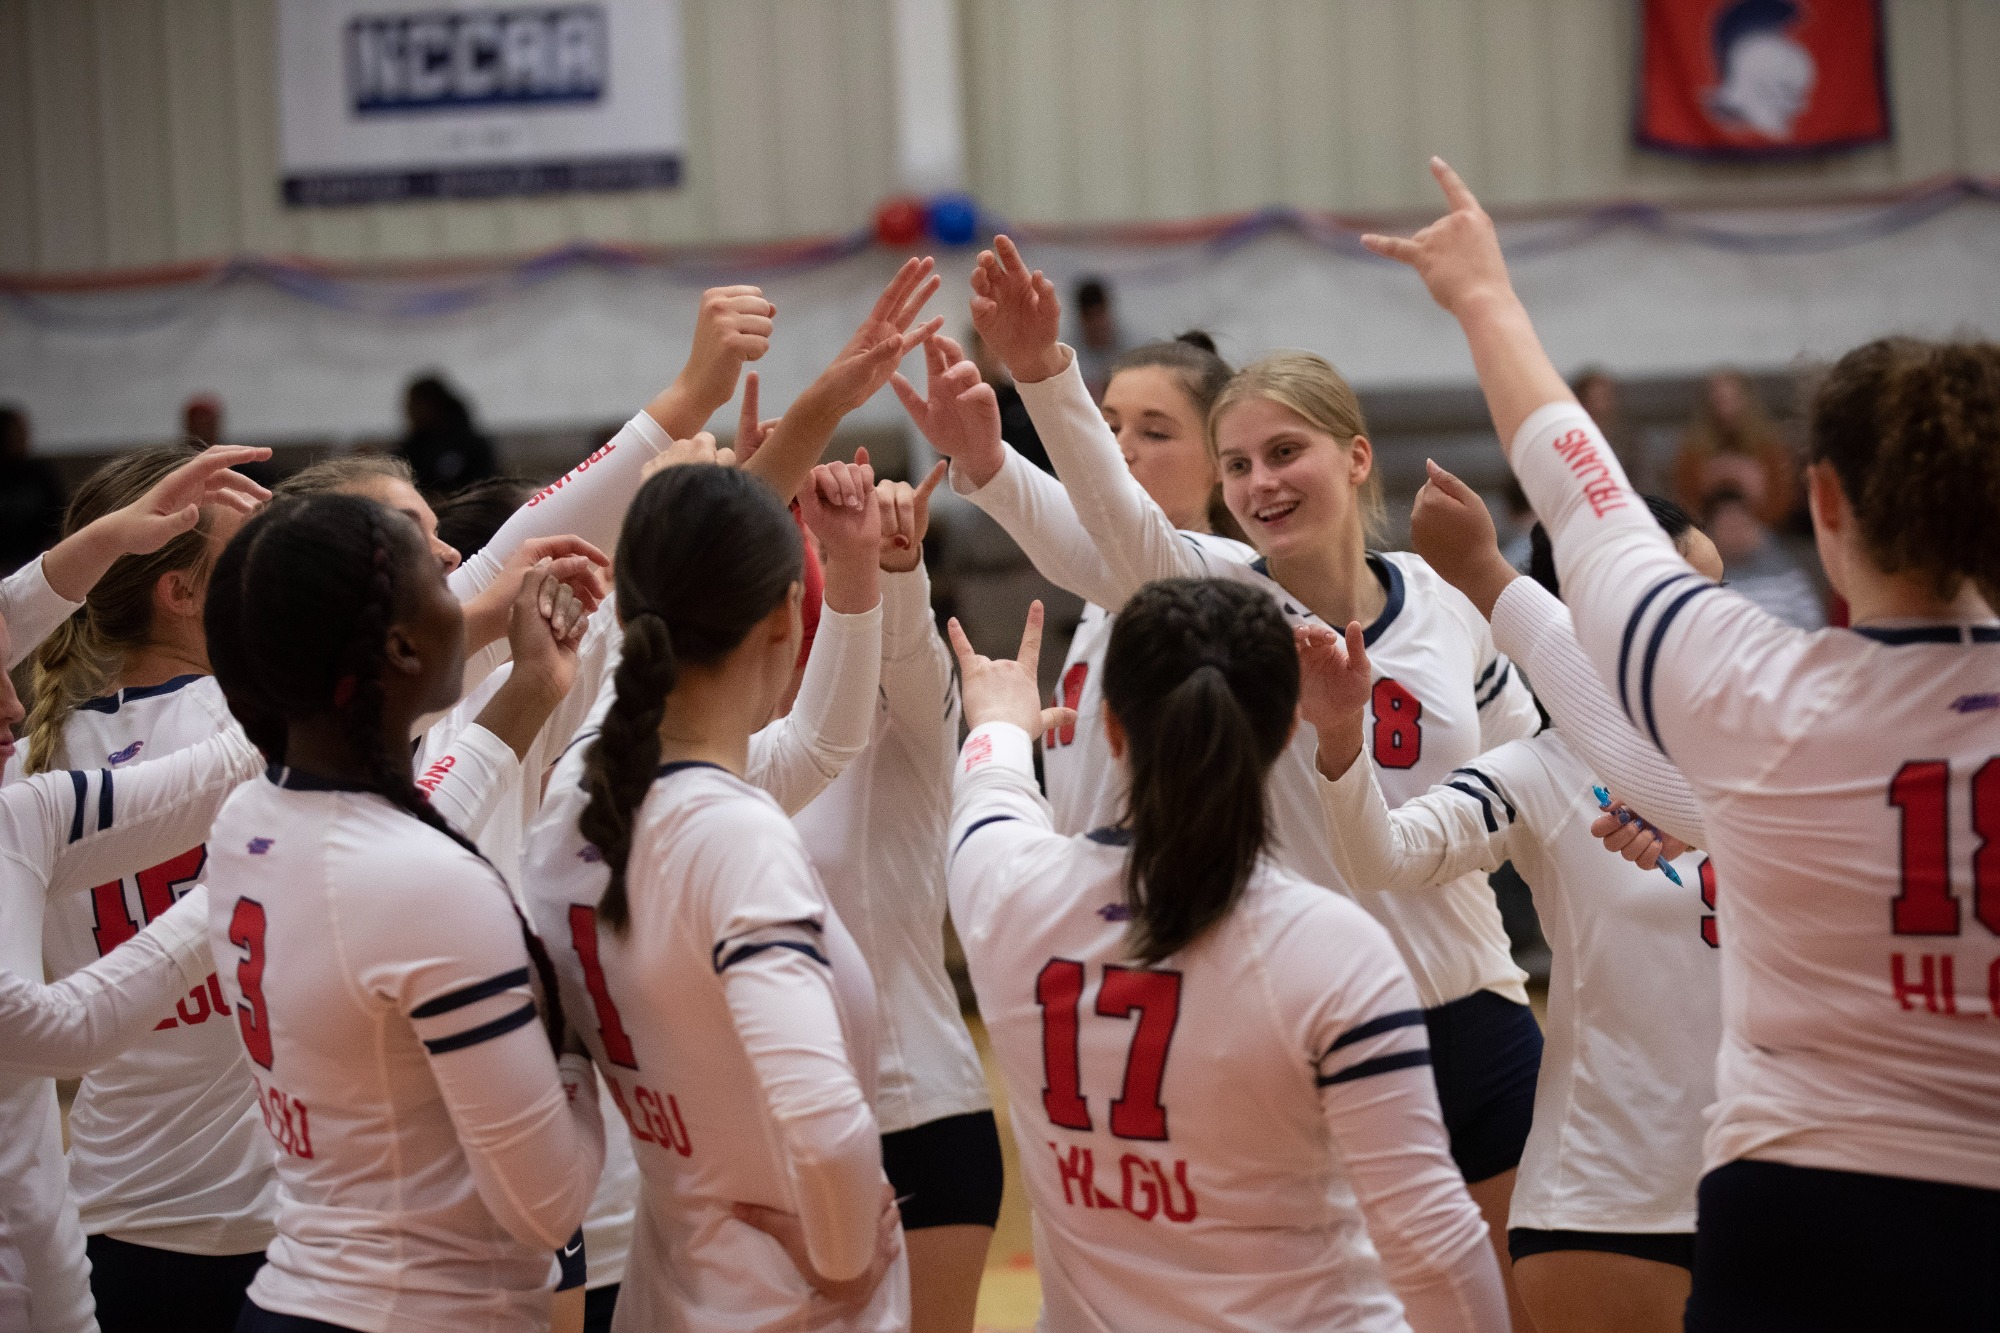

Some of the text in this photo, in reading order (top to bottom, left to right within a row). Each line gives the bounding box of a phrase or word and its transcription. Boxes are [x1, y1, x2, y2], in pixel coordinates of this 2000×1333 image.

[354, 16, 598, 97] NCCAA
[1552, 429, 1629, 518] TROJANS
[1372, 676, 1422, 769] 8
[229, 895, 274, 1072] 3
[568, 903, 640, 1071] 1
[1036, 957, 1183, 1142] 17
[1048, 1141, 1199, 1224] HLGU
